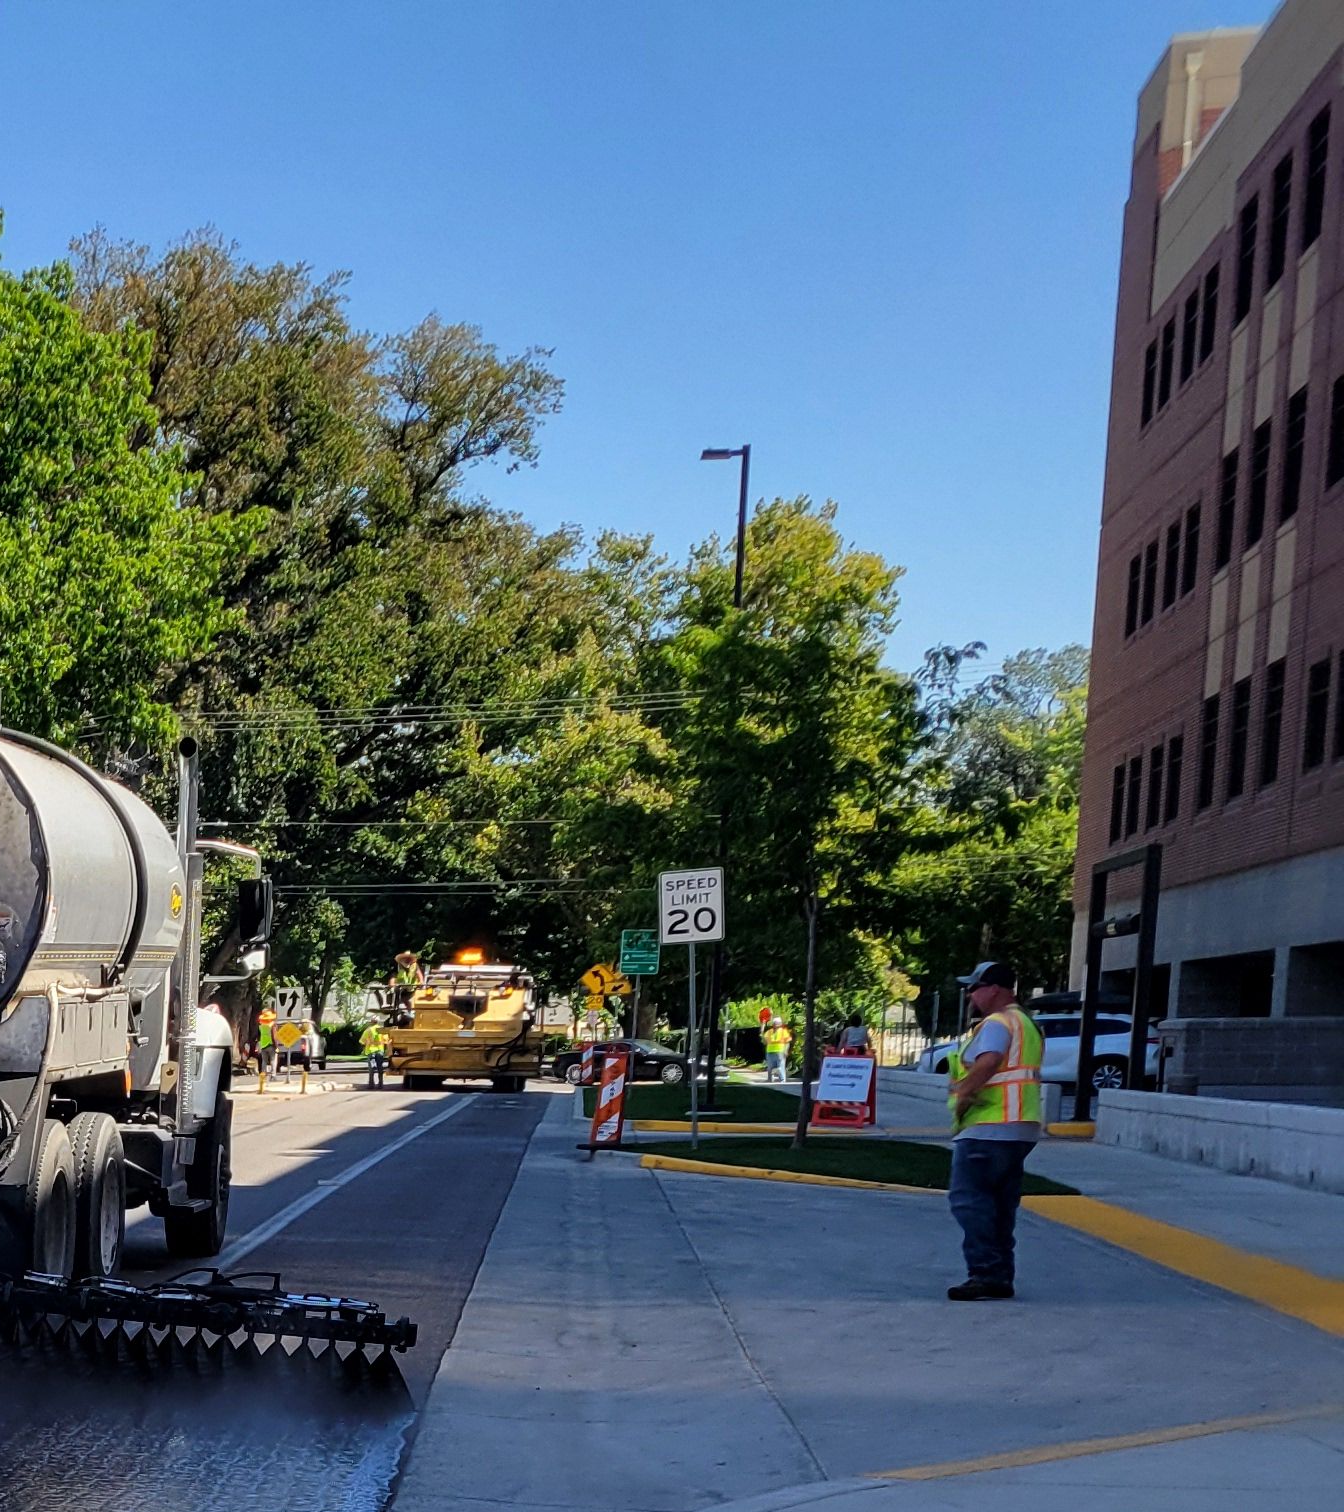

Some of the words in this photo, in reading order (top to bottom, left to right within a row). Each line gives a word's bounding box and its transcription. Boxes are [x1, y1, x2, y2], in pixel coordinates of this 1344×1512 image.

[665, 877, 718, 891] SPEED
[671, 892, 711, 906] LIMIT
[667, 907, 716, 935] 20
